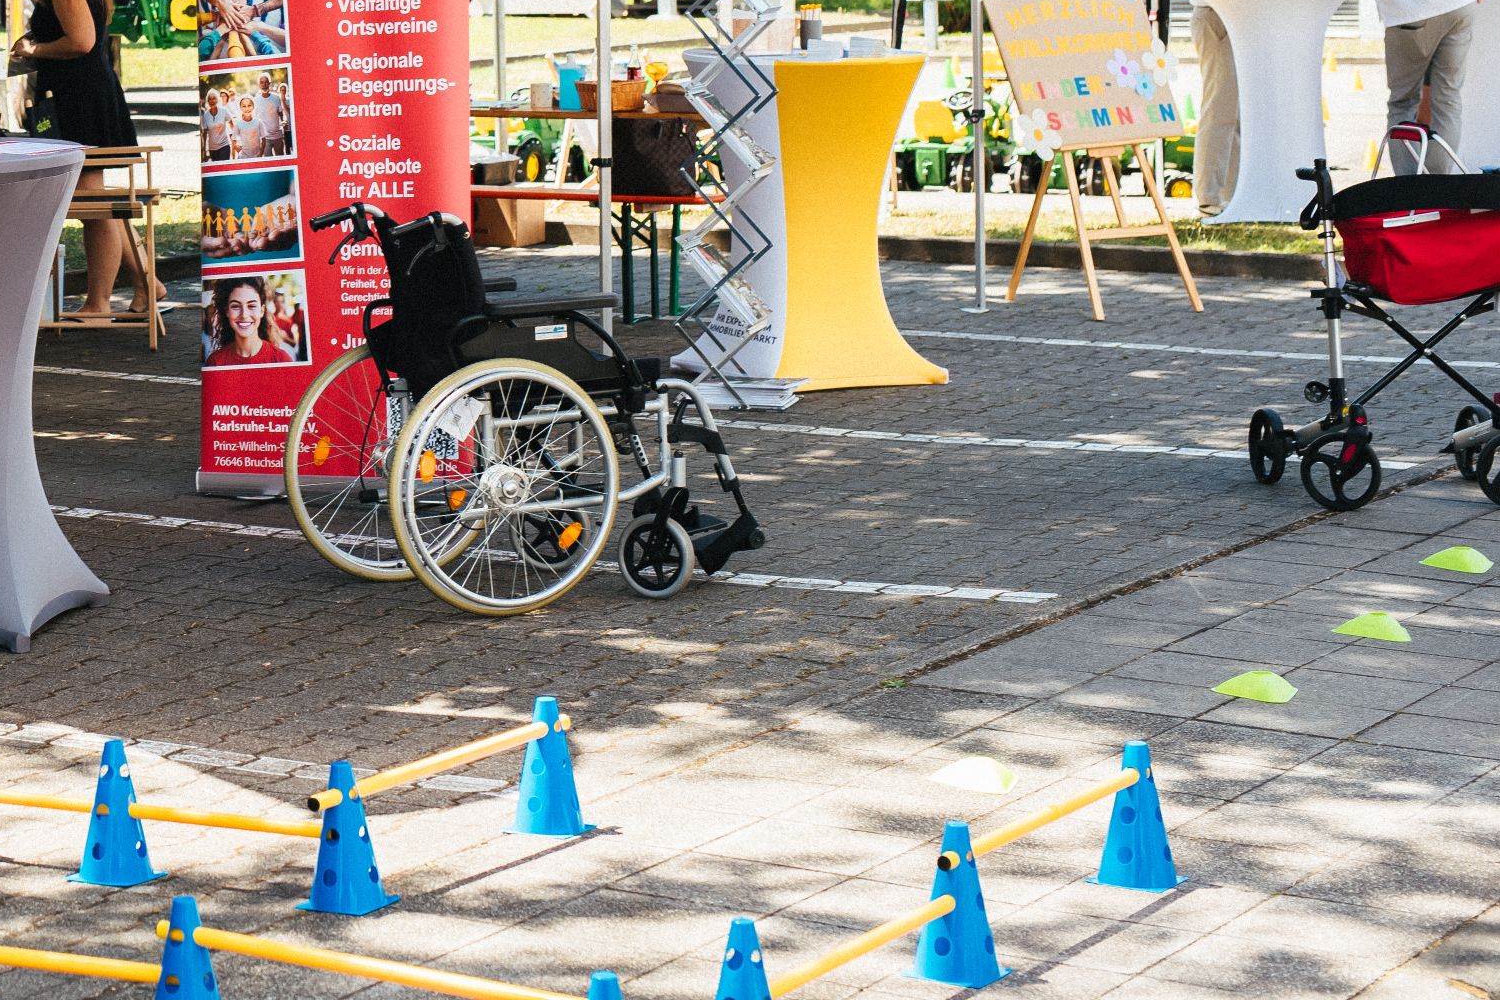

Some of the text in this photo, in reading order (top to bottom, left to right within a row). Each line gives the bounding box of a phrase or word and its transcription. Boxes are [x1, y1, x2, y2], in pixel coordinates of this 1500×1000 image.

[337, 17, 438, 37] Ortsvereine
[1004, 31, 1152, 58] WILLKOMMEN
[338, 51, 423, 73] Regionale
[338, 77, 456, 98] Begegnungs-
[338, 101, 402, 118] zentren
[338, 134, 401, 152] Soziale
[339, 158, 421, 179] Angebote
[339, 181, 415, 199] für ALLE
[340, 266, 355, 275] Wir
[357, 265, 365, 275] in
[367, 265, 382, 275] der
[340, 278, 378, 290] Freiheit,
[341, 306, 359, 316] und
[212, 405, 239, 416] AWO
[212, 421, 289, 433] Karlsruhe-Lan
[214, 456, 284, 468] 76646 Bruchsal
